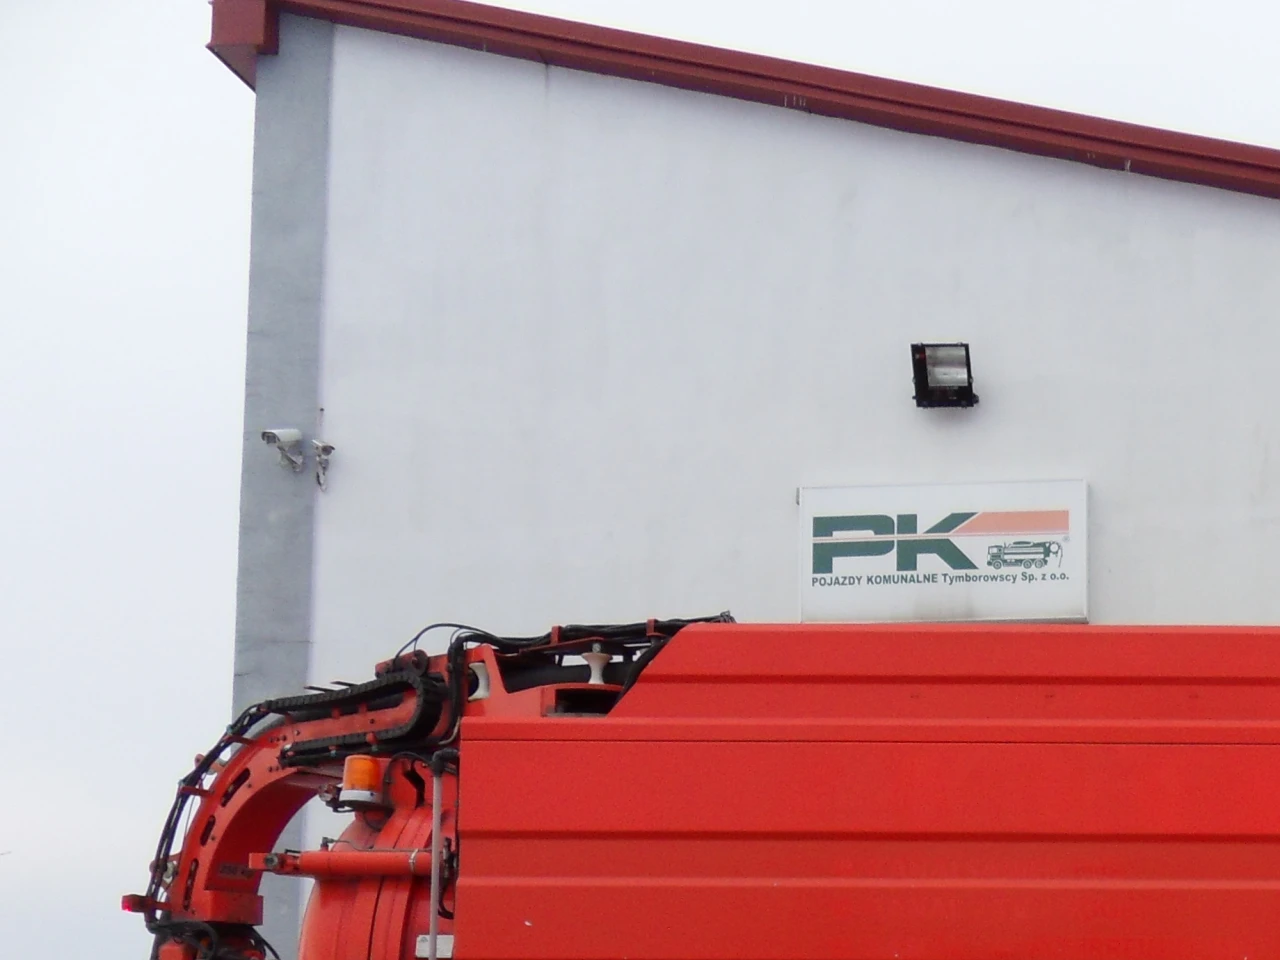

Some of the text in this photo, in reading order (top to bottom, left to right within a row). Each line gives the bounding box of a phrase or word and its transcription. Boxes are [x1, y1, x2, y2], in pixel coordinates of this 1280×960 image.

[812, 512, 979, 574] PK
[811, 575, 863, 587] POJAZDY
[866, 573, 938, 585] KOMUNALNE
[942, 572, 1018, 586] Tymborowscy
[1021, 571, 1038, 583] Sp.
[1050, 572, 1070, 581] o.o.
